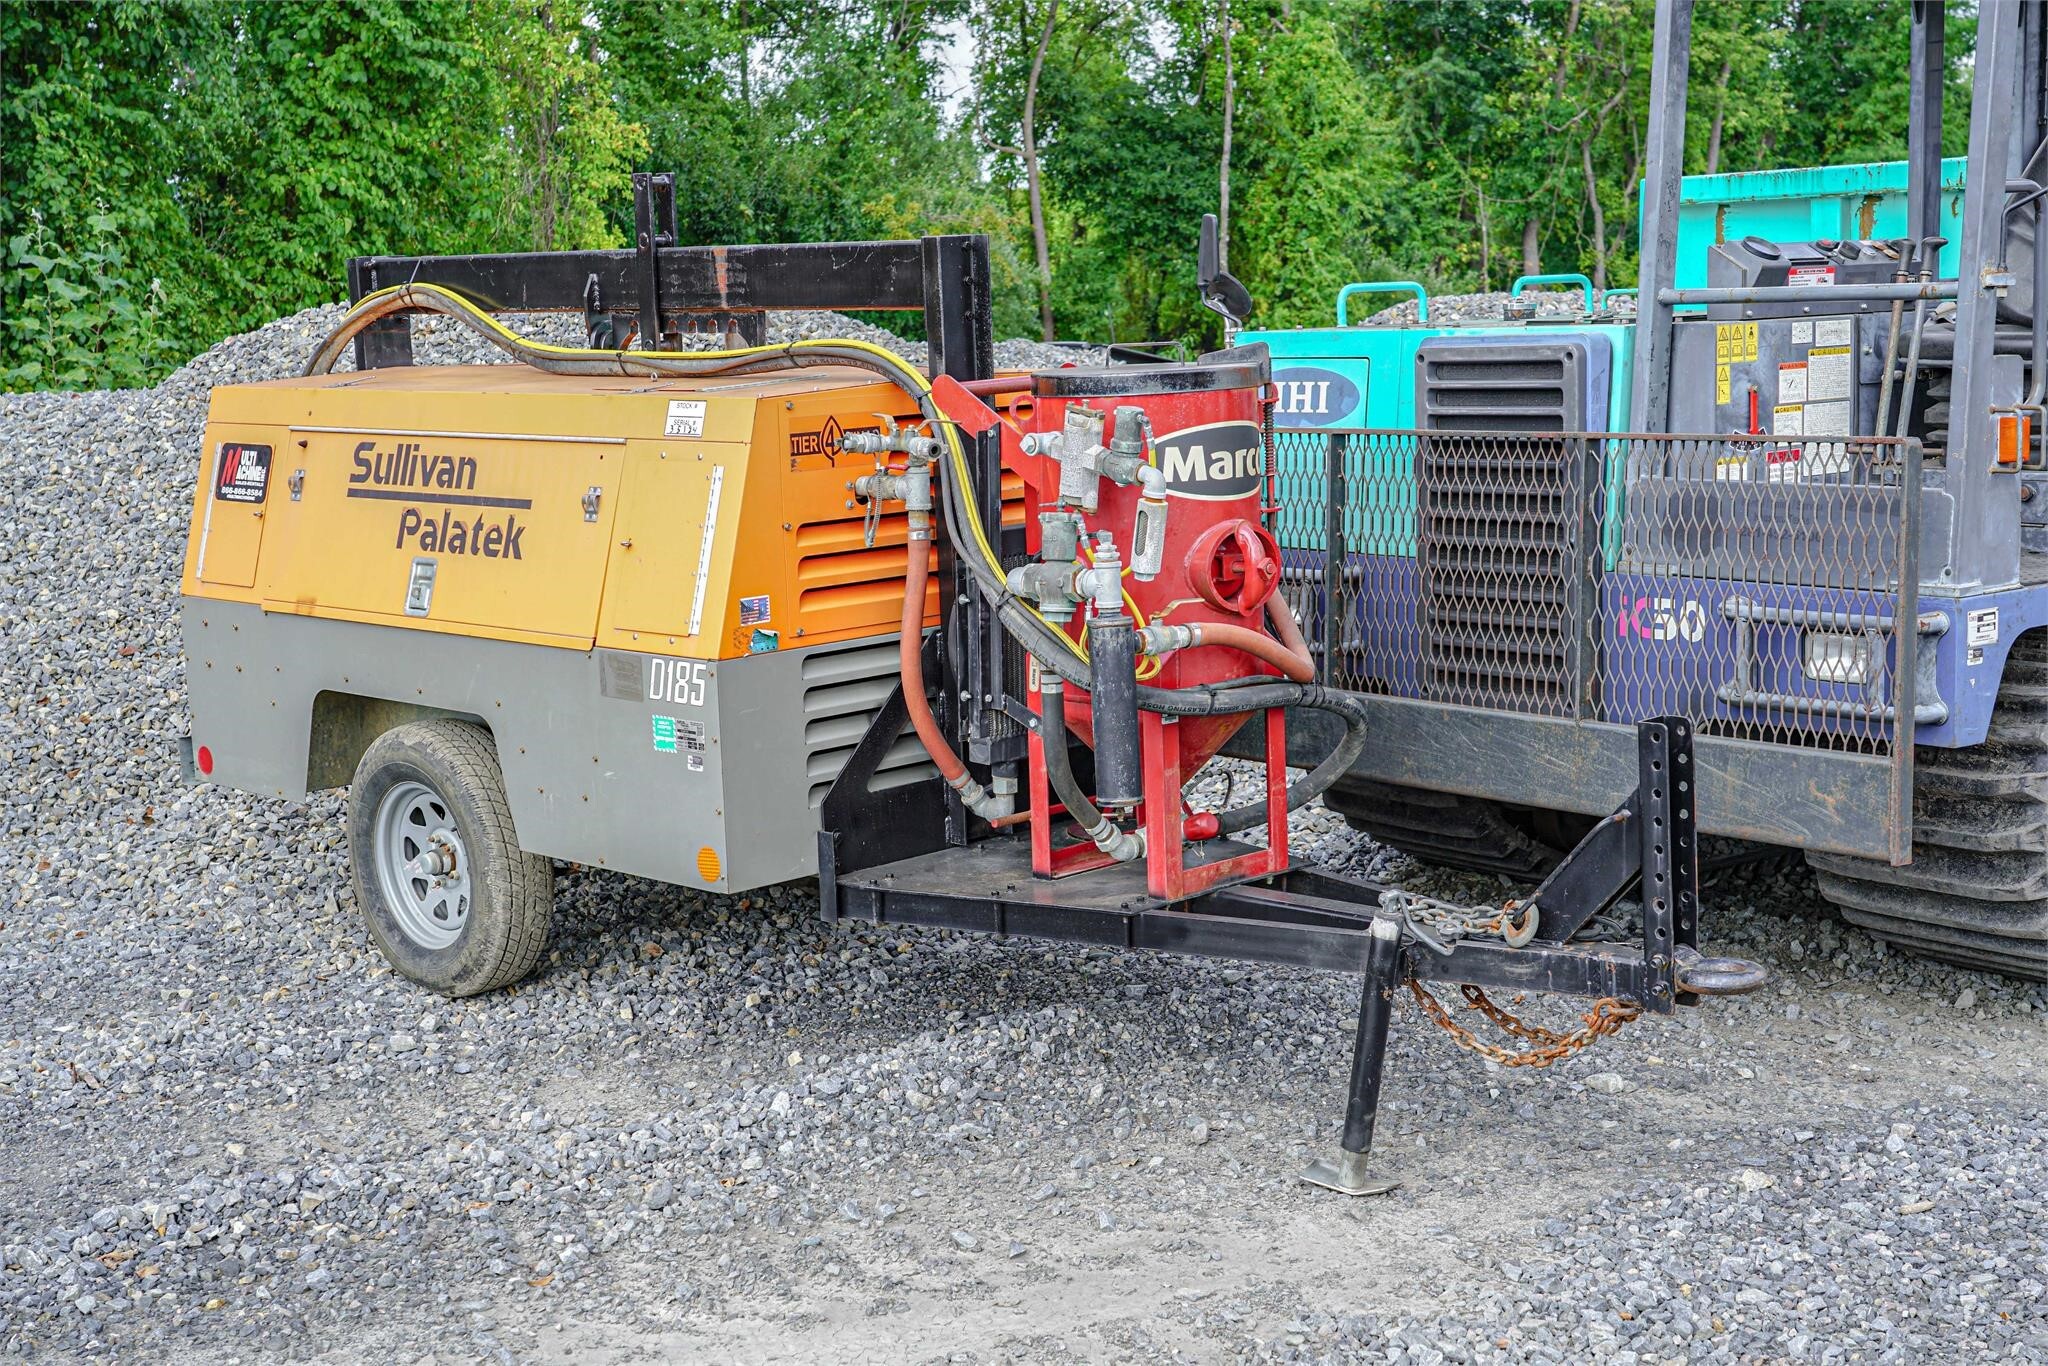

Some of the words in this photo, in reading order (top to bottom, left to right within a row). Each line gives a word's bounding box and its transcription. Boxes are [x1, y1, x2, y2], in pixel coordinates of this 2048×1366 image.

[1817, 348, 1850, 356] CAUTION
[1273, 381, 1331, 413] IHI
[1780, 405, 1801, 413] CAUTION
[791, 435, 819, 454] TIER
[349, 441, 478, 490] Sullivan
[396, 507, 526, 561] Palatek
[649, 658, 707, 707] D185
[1140, 701, 1165, 711] HOSE
[1167, 704, 1207, 713] BLASTING
